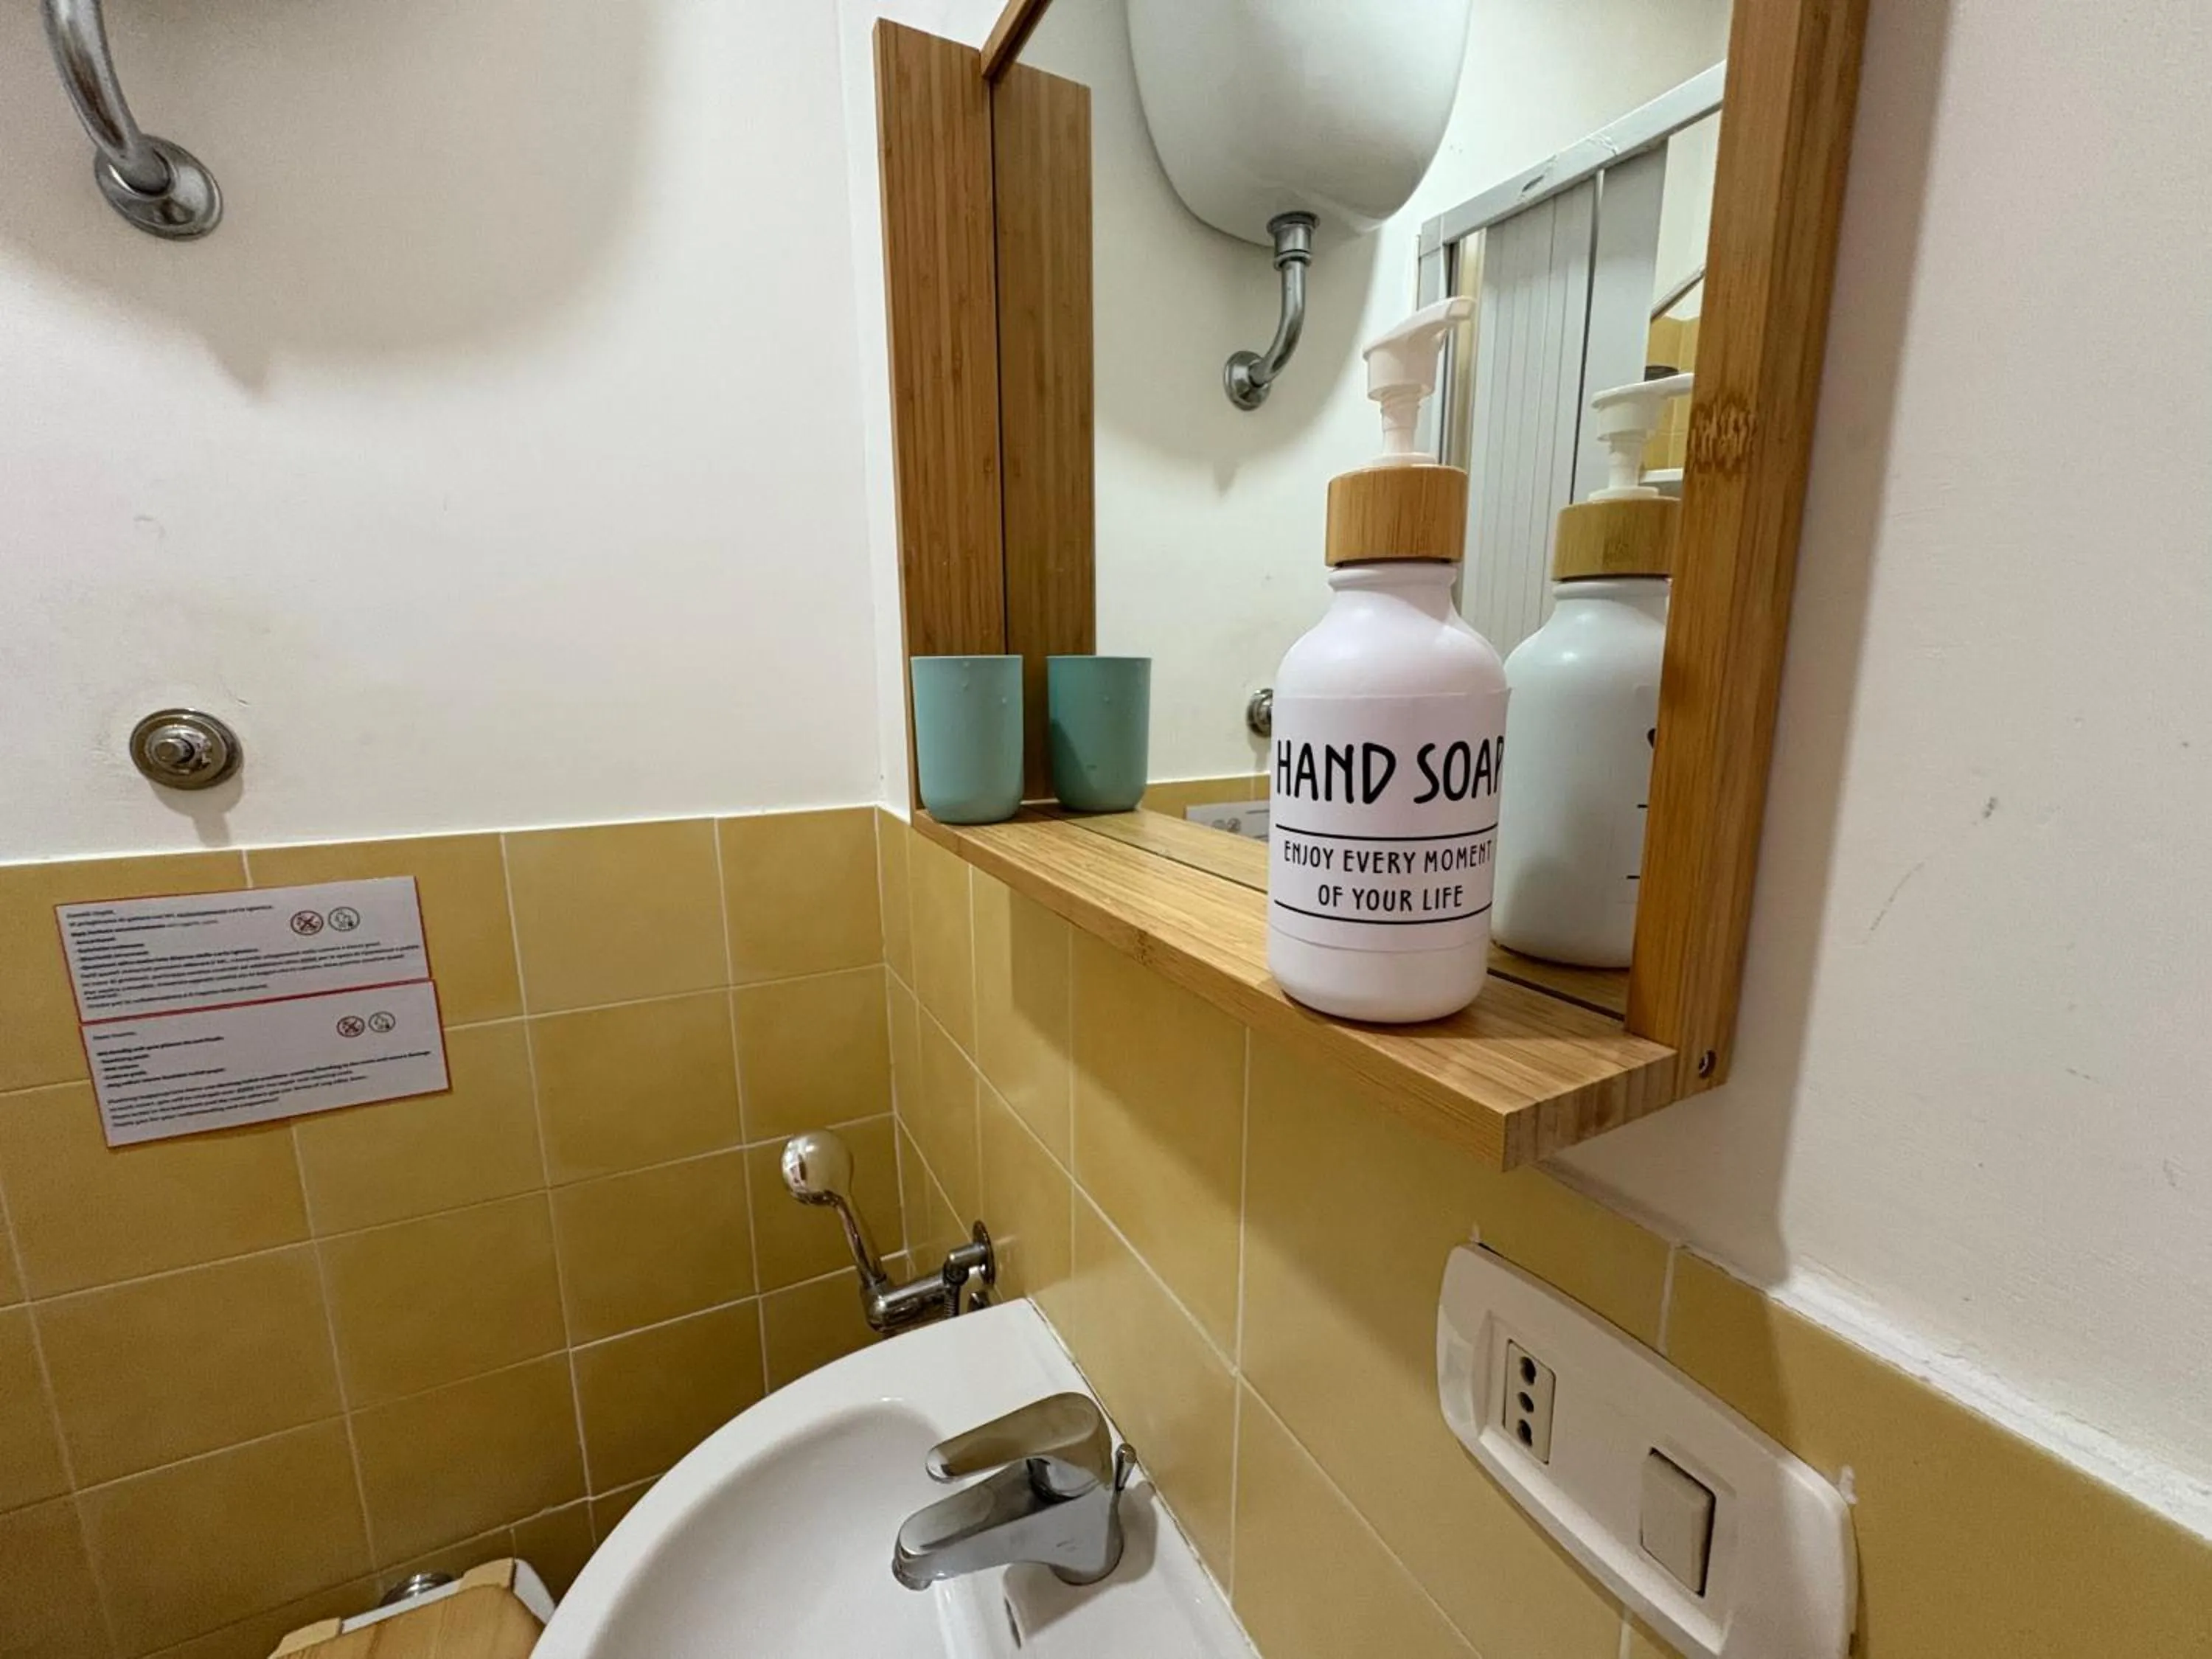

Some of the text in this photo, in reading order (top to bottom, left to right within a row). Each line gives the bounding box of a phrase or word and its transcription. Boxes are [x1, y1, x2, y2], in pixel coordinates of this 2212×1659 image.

[1276, 735, 1505, 804] HAND SOAP
[1284, 839, 1492, 874] ENJOY EVERY MOMENT
[1318, 884, 1464, 912] OF YOUR LIFE
